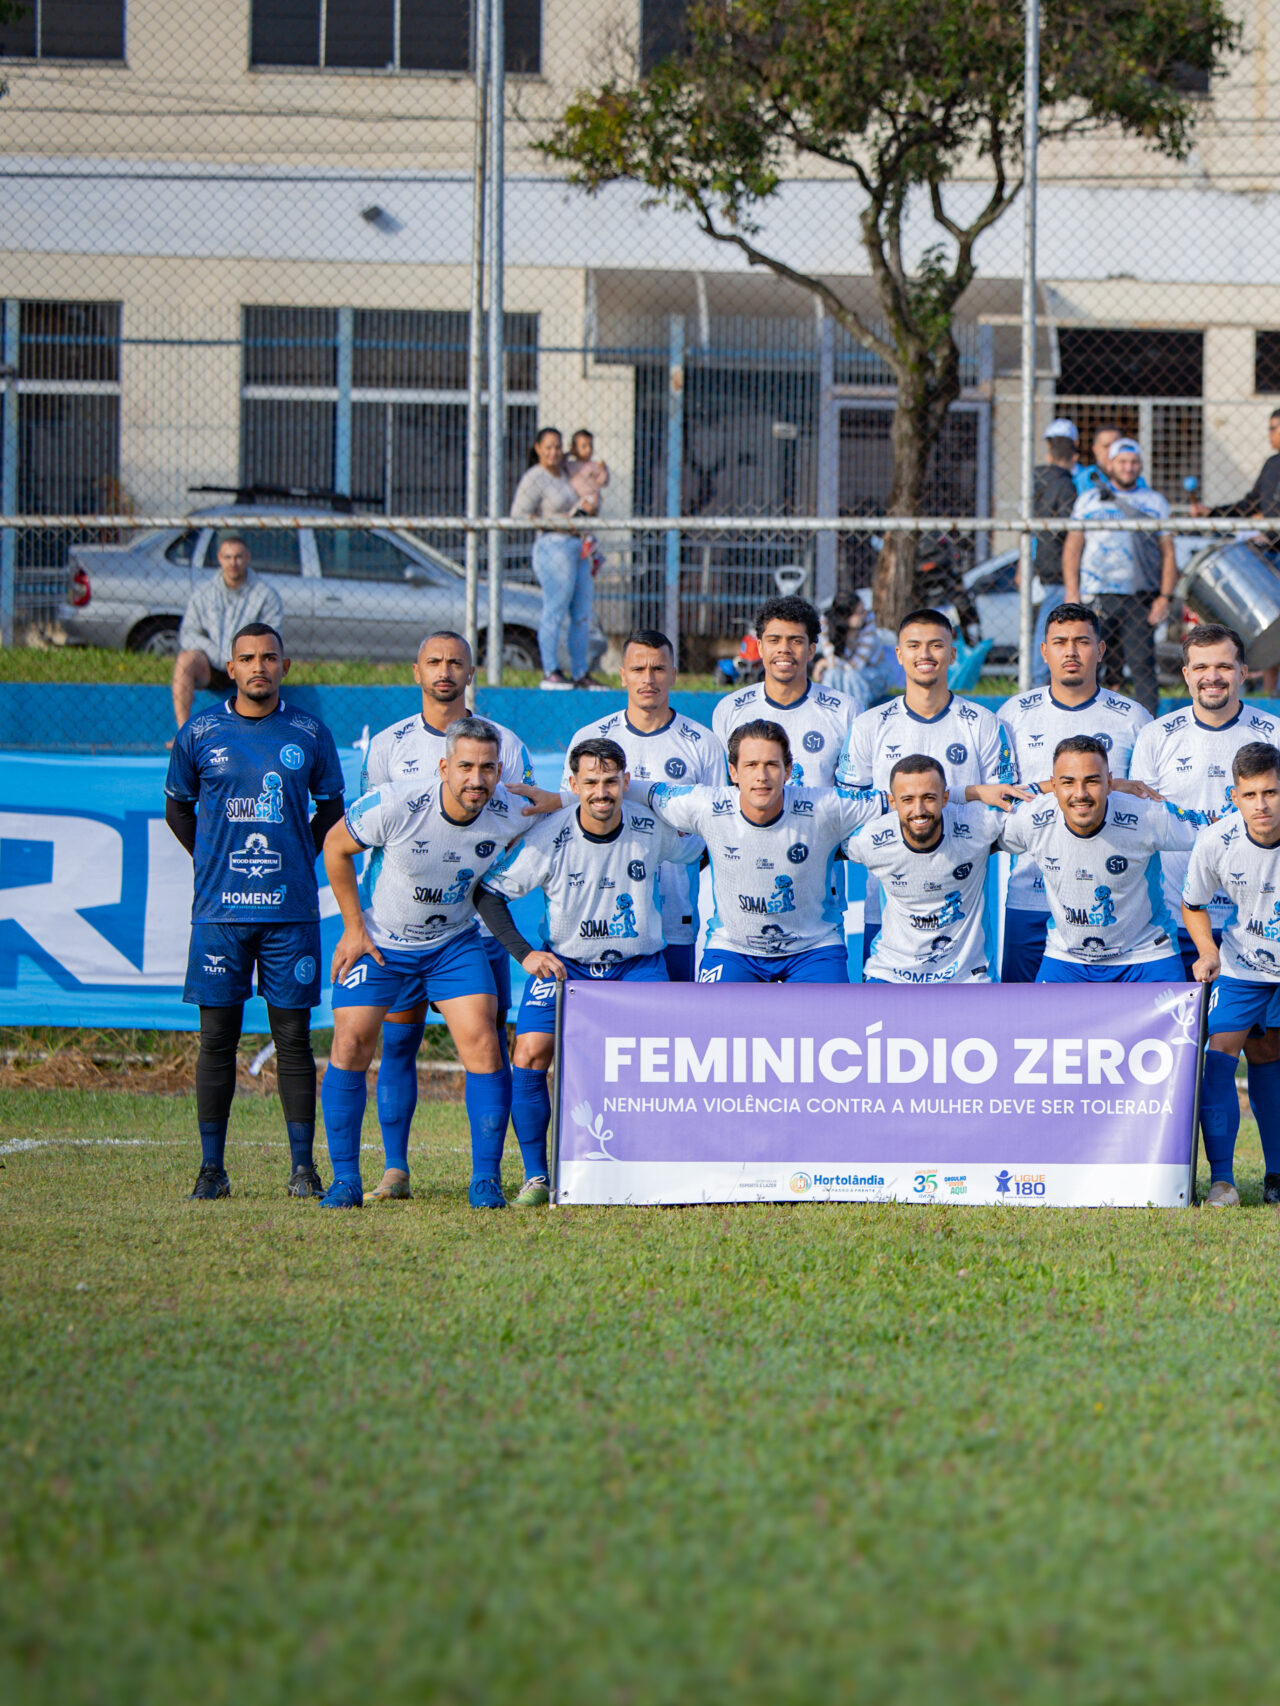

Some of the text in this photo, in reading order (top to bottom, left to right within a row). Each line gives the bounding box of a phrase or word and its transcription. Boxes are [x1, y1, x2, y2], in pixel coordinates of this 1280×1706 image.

[816, 692, 841, 708] WR
[1019, 693, 1043, 709] WR
[1106, 697, 1132, 713] WR
[1162, 715, 1188, 732] WR
[1250, 715, 1275, 733] WR
[407, 794, 431, 813] WR
[792, 800, 814, 812] WR
[631, 816, 655, 830] WR
[1031, 810, 1055, 825] WR
[1113, 812, 1139, 826] WR
[871, 829, 896, 845] WR
[222, 892, 282, 905] HOMENZ
[203, 965, 226, 974] TUTI
[604, 1020, 1174, 1085] FEMINICÍDIO ZERO
[603, 1094, 1174, 1115] NENHUMA VIOLÊNCIA CONTRA A MULHER DEVE SER TOLERADA
[814, 1174, 885, 1186] Hortolândia
[1014, 1174, 1046, 1183] LIGUE
[950, 1186, 967, 1195] AQUI
[1014, 1182, 1046, 1196] 180
